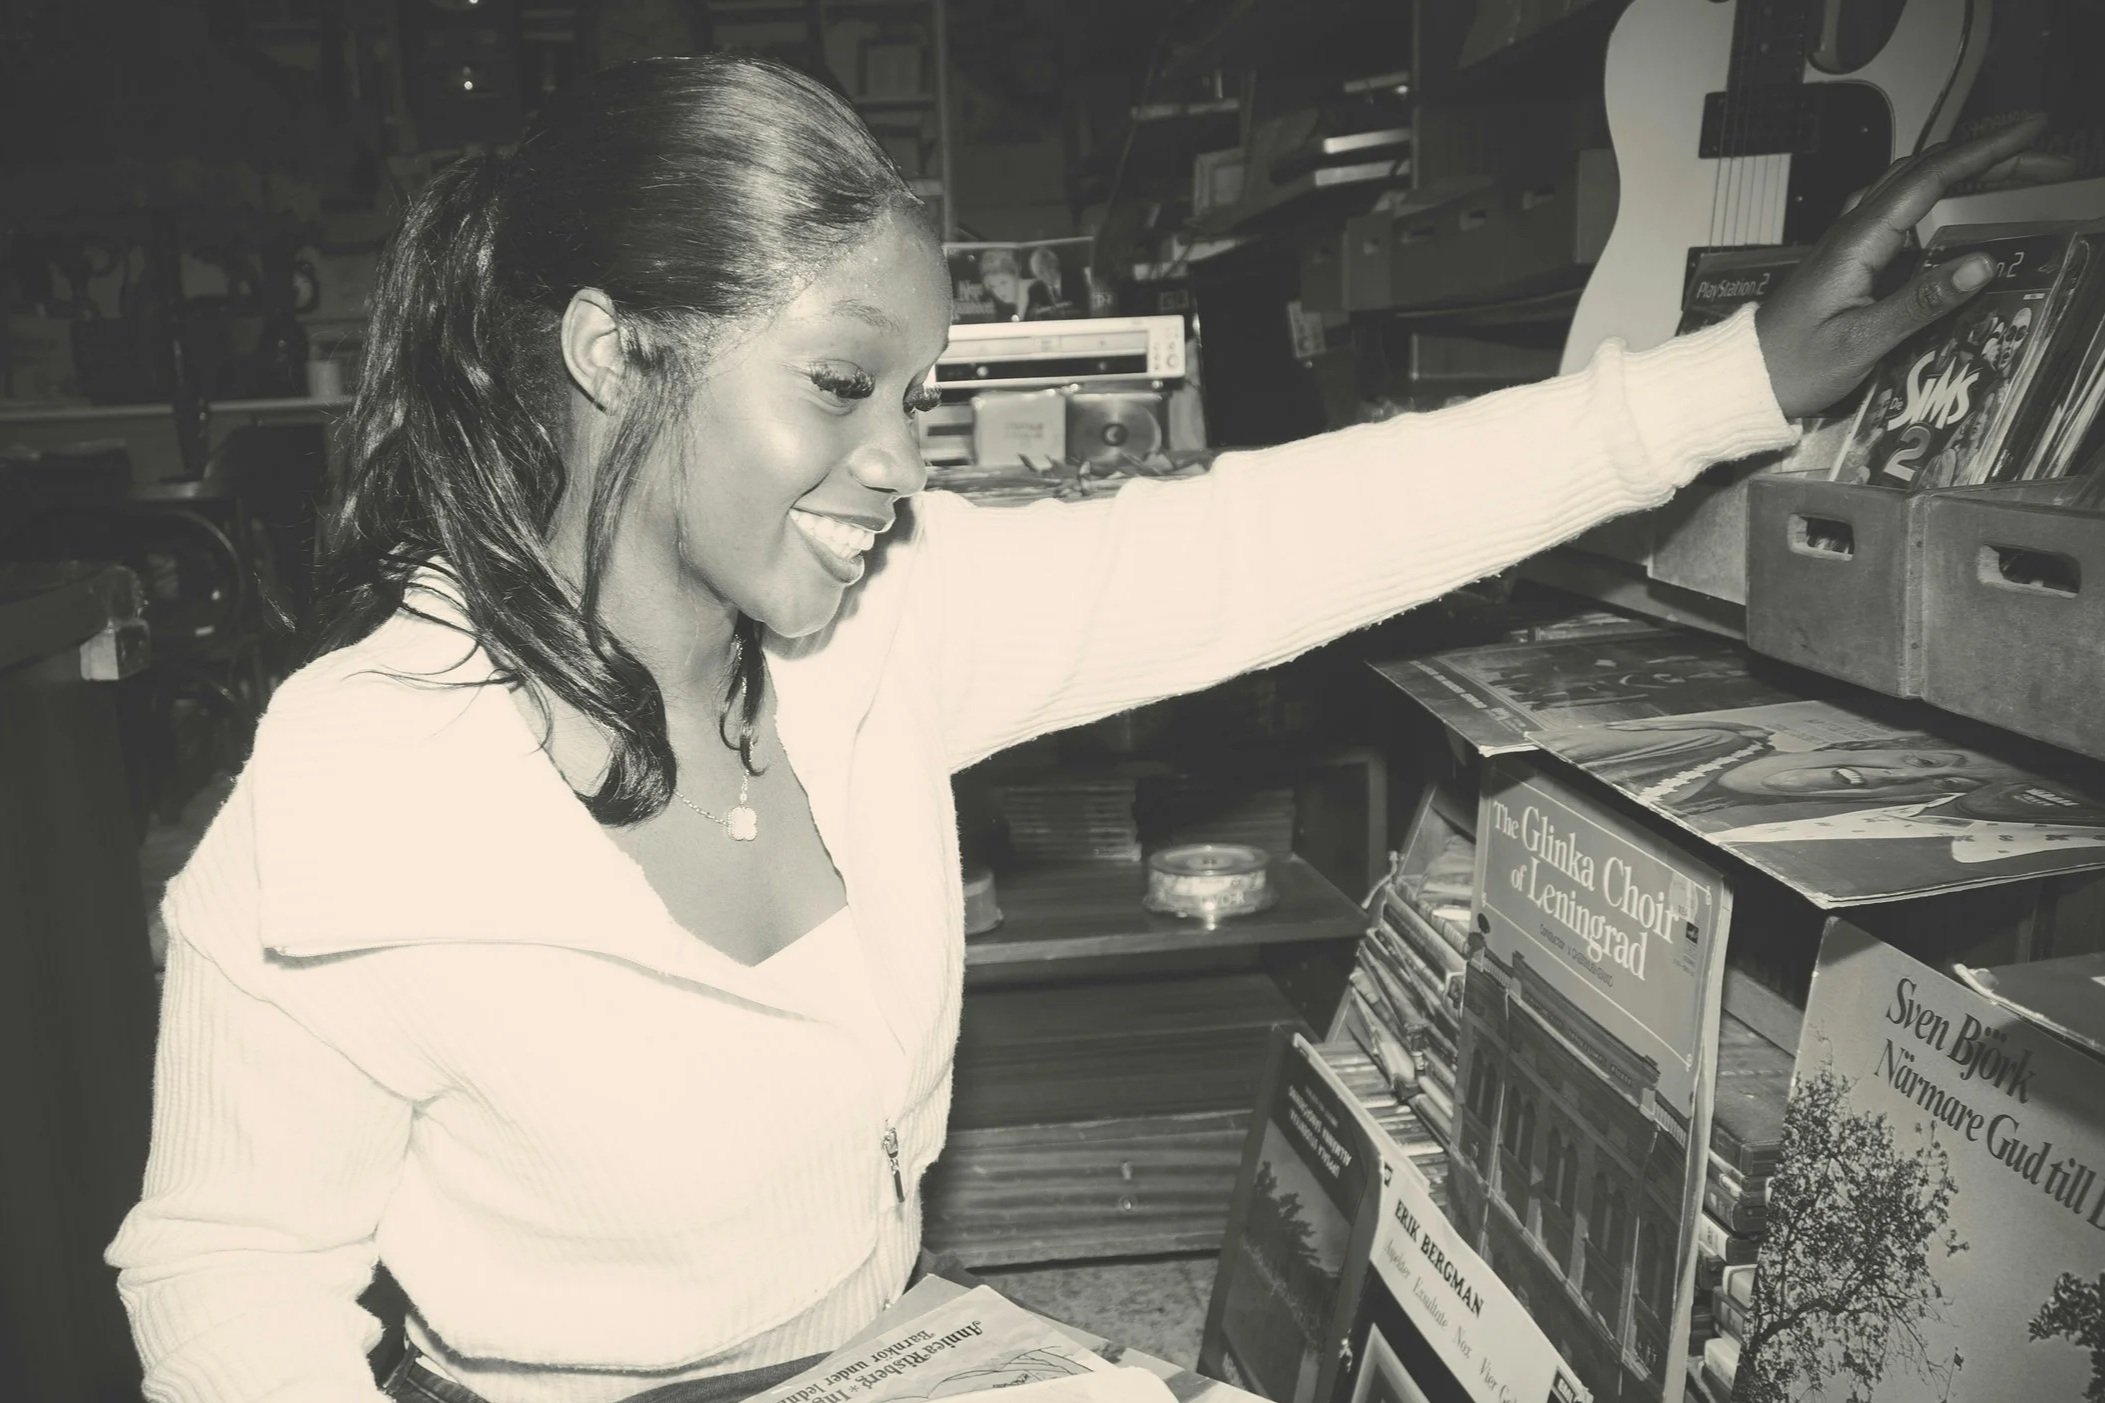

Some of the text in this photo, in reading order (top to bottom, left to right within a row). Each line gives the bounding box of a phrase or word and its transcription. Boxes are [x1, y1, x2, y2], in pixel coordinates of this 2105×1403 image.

[1884, 425, 1931, 481] 2
[1493, 800, 1680, 943] The Glinka Choir
[1510, 865, 1528, 891] of
[1528, 856, 1648, 981] Leningrad
[1885, 977, 2037, 1104] Sven Björk
[1873, 1038, 1985, 1141] Närmare
[1987, 1114, 2052, 1185] Gud
[2044, 1158, 2097, 1214] till
[1394, 1199, 1484, 1319] ERIK BERGMAN
[823, 1359, 870, 1387] under
[854, 1352, 931, 1390] Risberg
[870, 1330, 936, 1363] Barnkör
[921, 1320, 984, 1354] Annica
